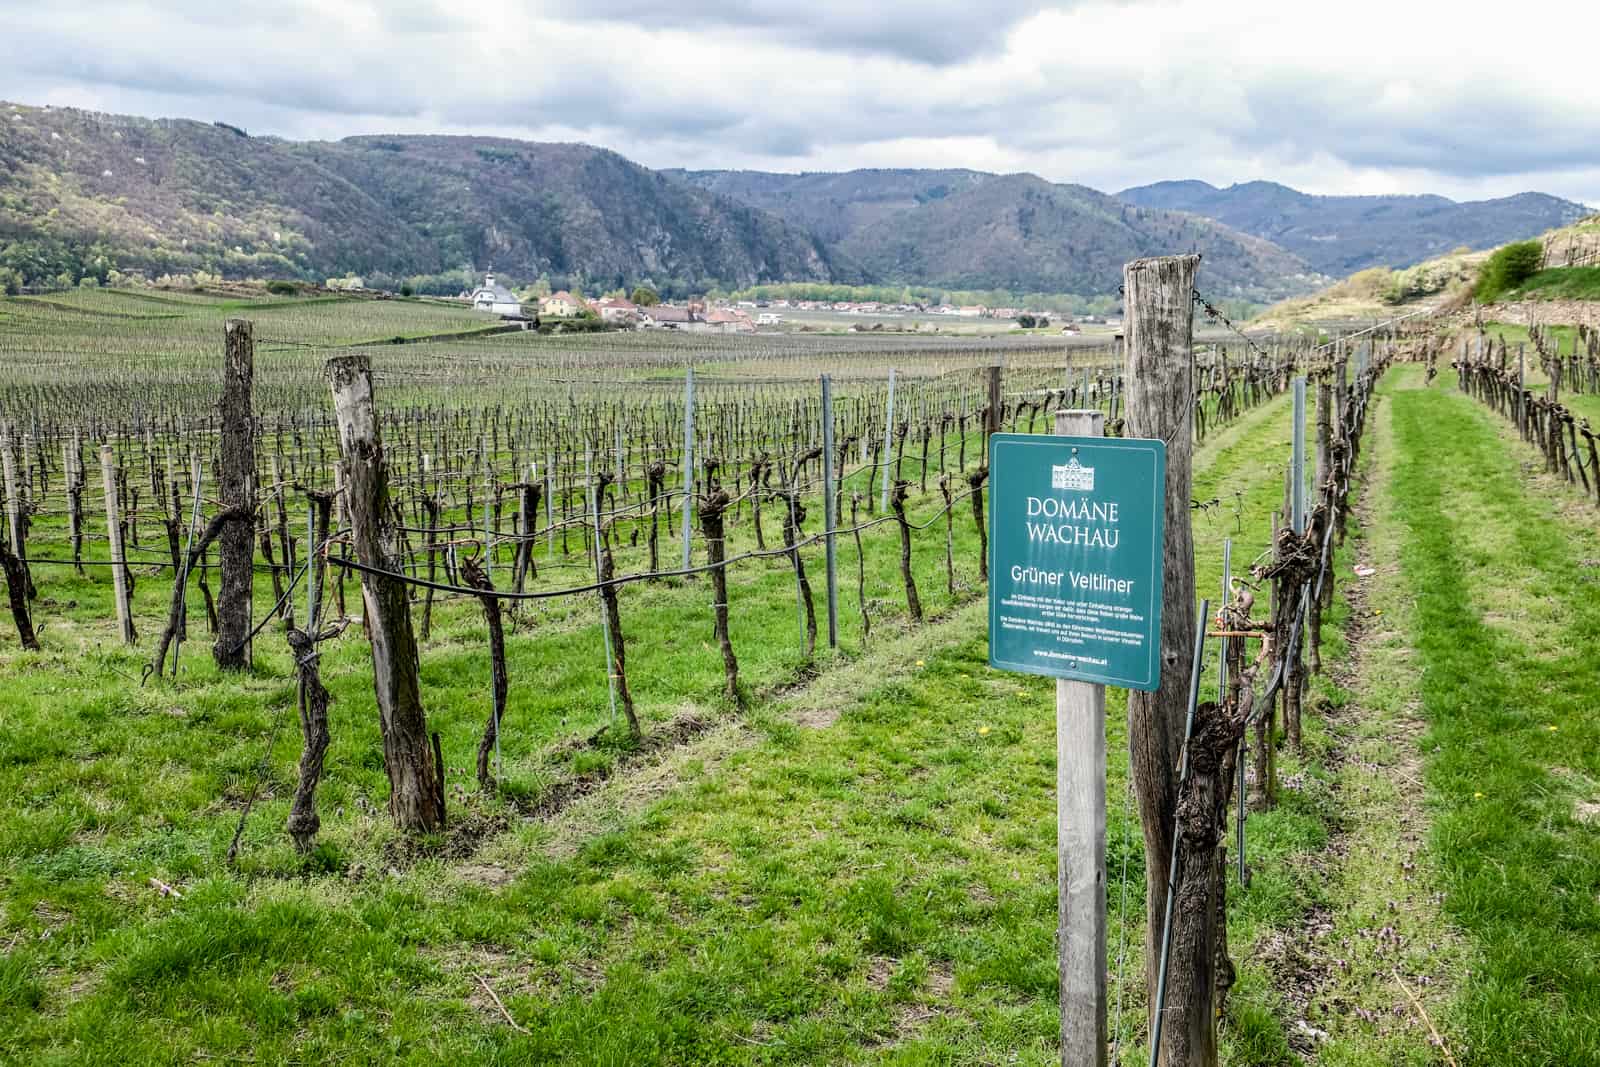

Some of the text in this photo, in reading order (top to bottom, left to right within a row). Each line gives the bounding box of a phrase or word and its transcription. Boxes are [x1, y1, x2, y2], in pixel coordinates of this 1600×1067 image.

[1027, 497, 1119, 522] DOMÄNE
[1026, 522, 1120, 549] WACHAU
[1011, 565, 1134, 593] Grüner Veltliner
